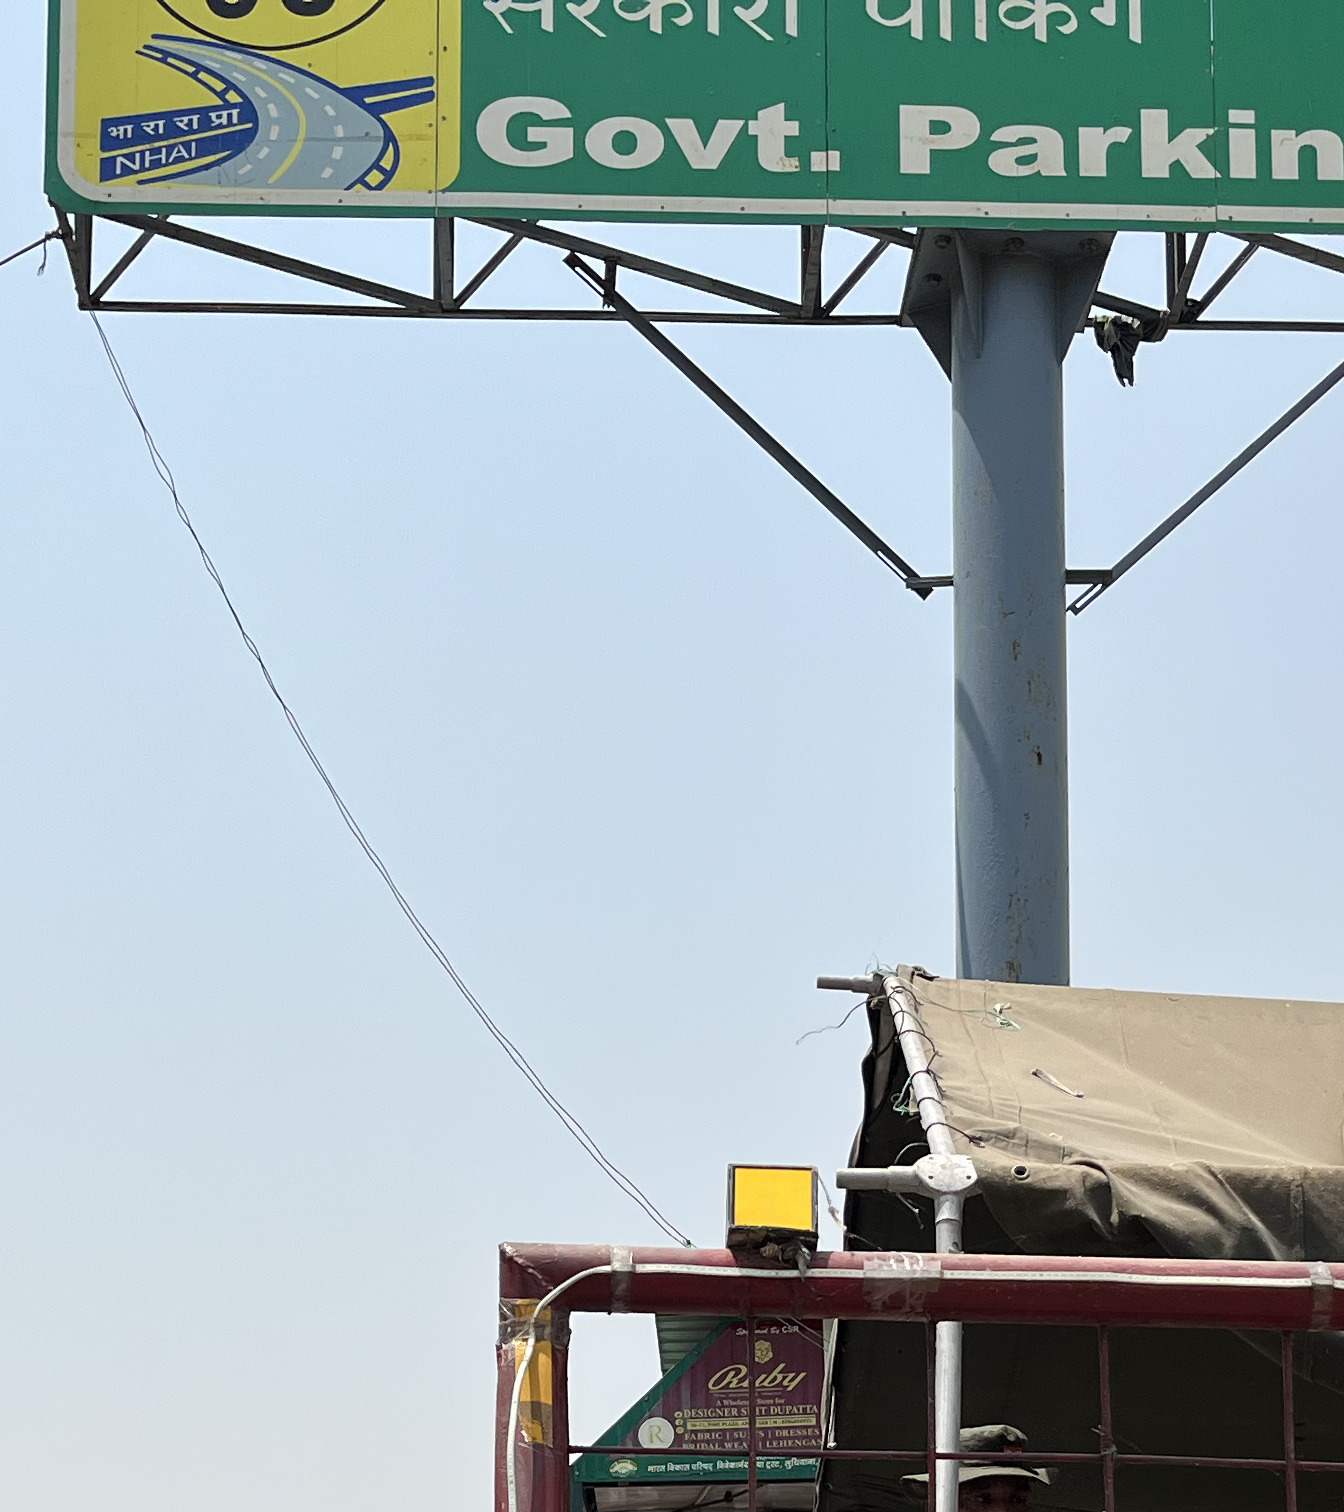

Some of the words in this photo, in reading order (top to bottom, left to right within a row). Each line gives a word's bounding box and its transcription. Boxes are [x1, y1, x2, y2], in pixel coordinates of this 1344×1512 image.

[107, 124, 134, 140] भा
[141, 119, 166, 137] रा
[173, 114, 201, 132] रा
[208, 107, 241, 127] प्रा
[475, 95, 840, 173] Govt.
[114, 141, 197, 176] NHAI
[708, 1363, 807, 1391] Ruby
[683, 1407, 738, 1418] DESIGNER
[740, 1406, 768, 1417] SIT
[770, 1405, 818, 1415] DUPATTA
[684, 1431, 723, 1441] FABRIC
[732, 1430, 765, 1440] SUS
[775, 1428, 820, 1438] DRESSES
[723, 1441, 749, 1449] WEA
